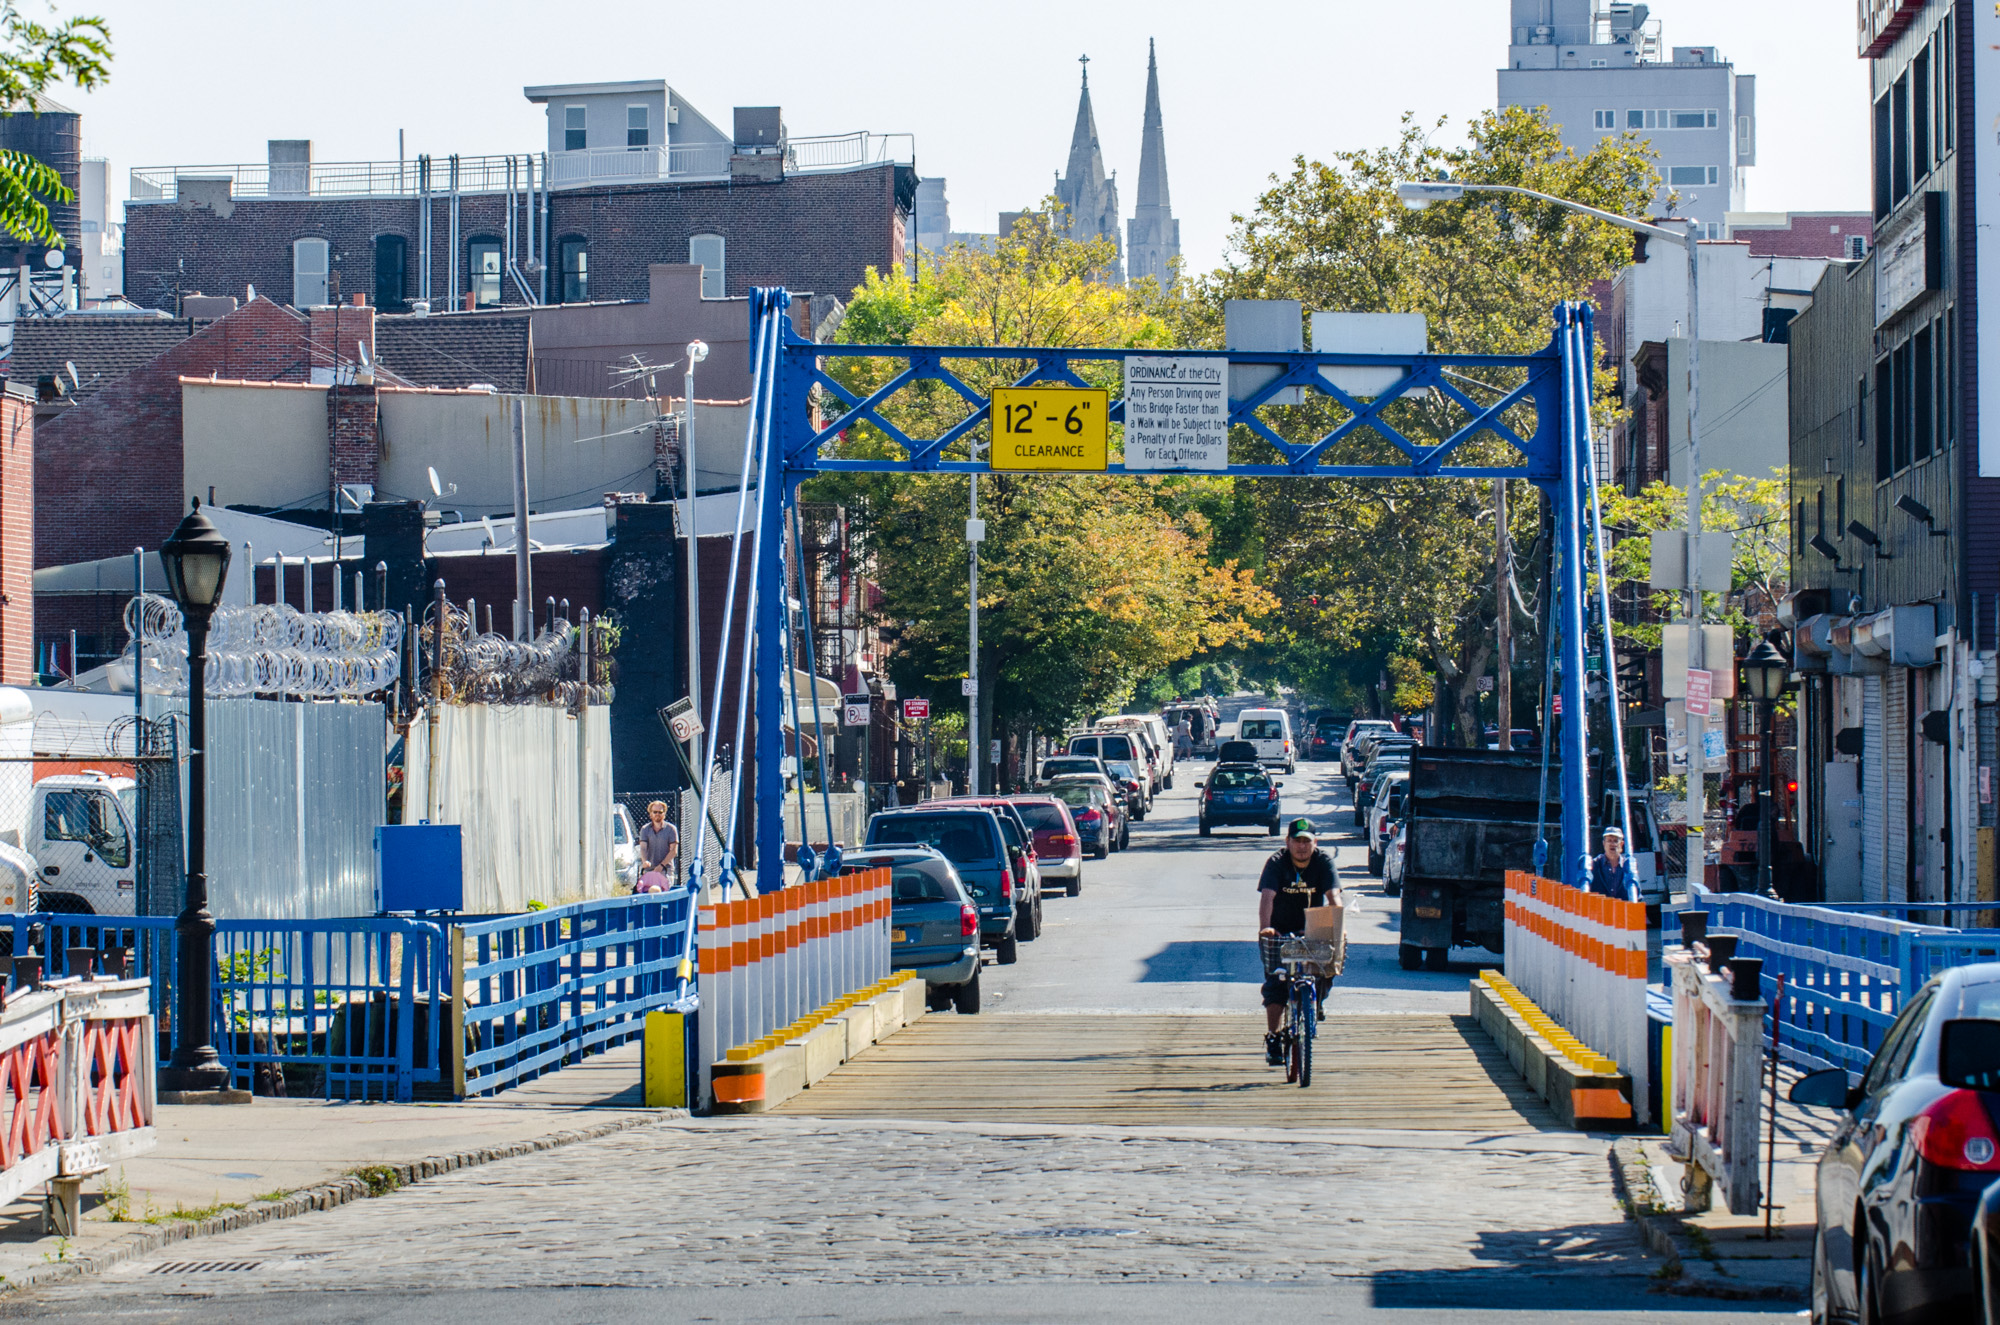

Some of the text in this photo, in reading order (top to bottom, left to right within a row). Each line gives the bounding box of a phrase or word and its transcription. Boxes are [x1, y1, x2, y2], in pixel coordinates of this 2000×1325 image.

[1130, 366, 1221, 382] ORDINANCE of the City
[1130, 386, 1221, 402] Any Person Driving over
[1133, 402, 1219, 417] this Bridge Faster than
[1130, 418, 1222, 433] a Walk will be Subject to
[1130, 432, 1222, 446] a Penalty of Five Dollars
[1014, 445, 1084, 457] CLEARANCE
[1145, 448, 1208, 460] For Each Offence
